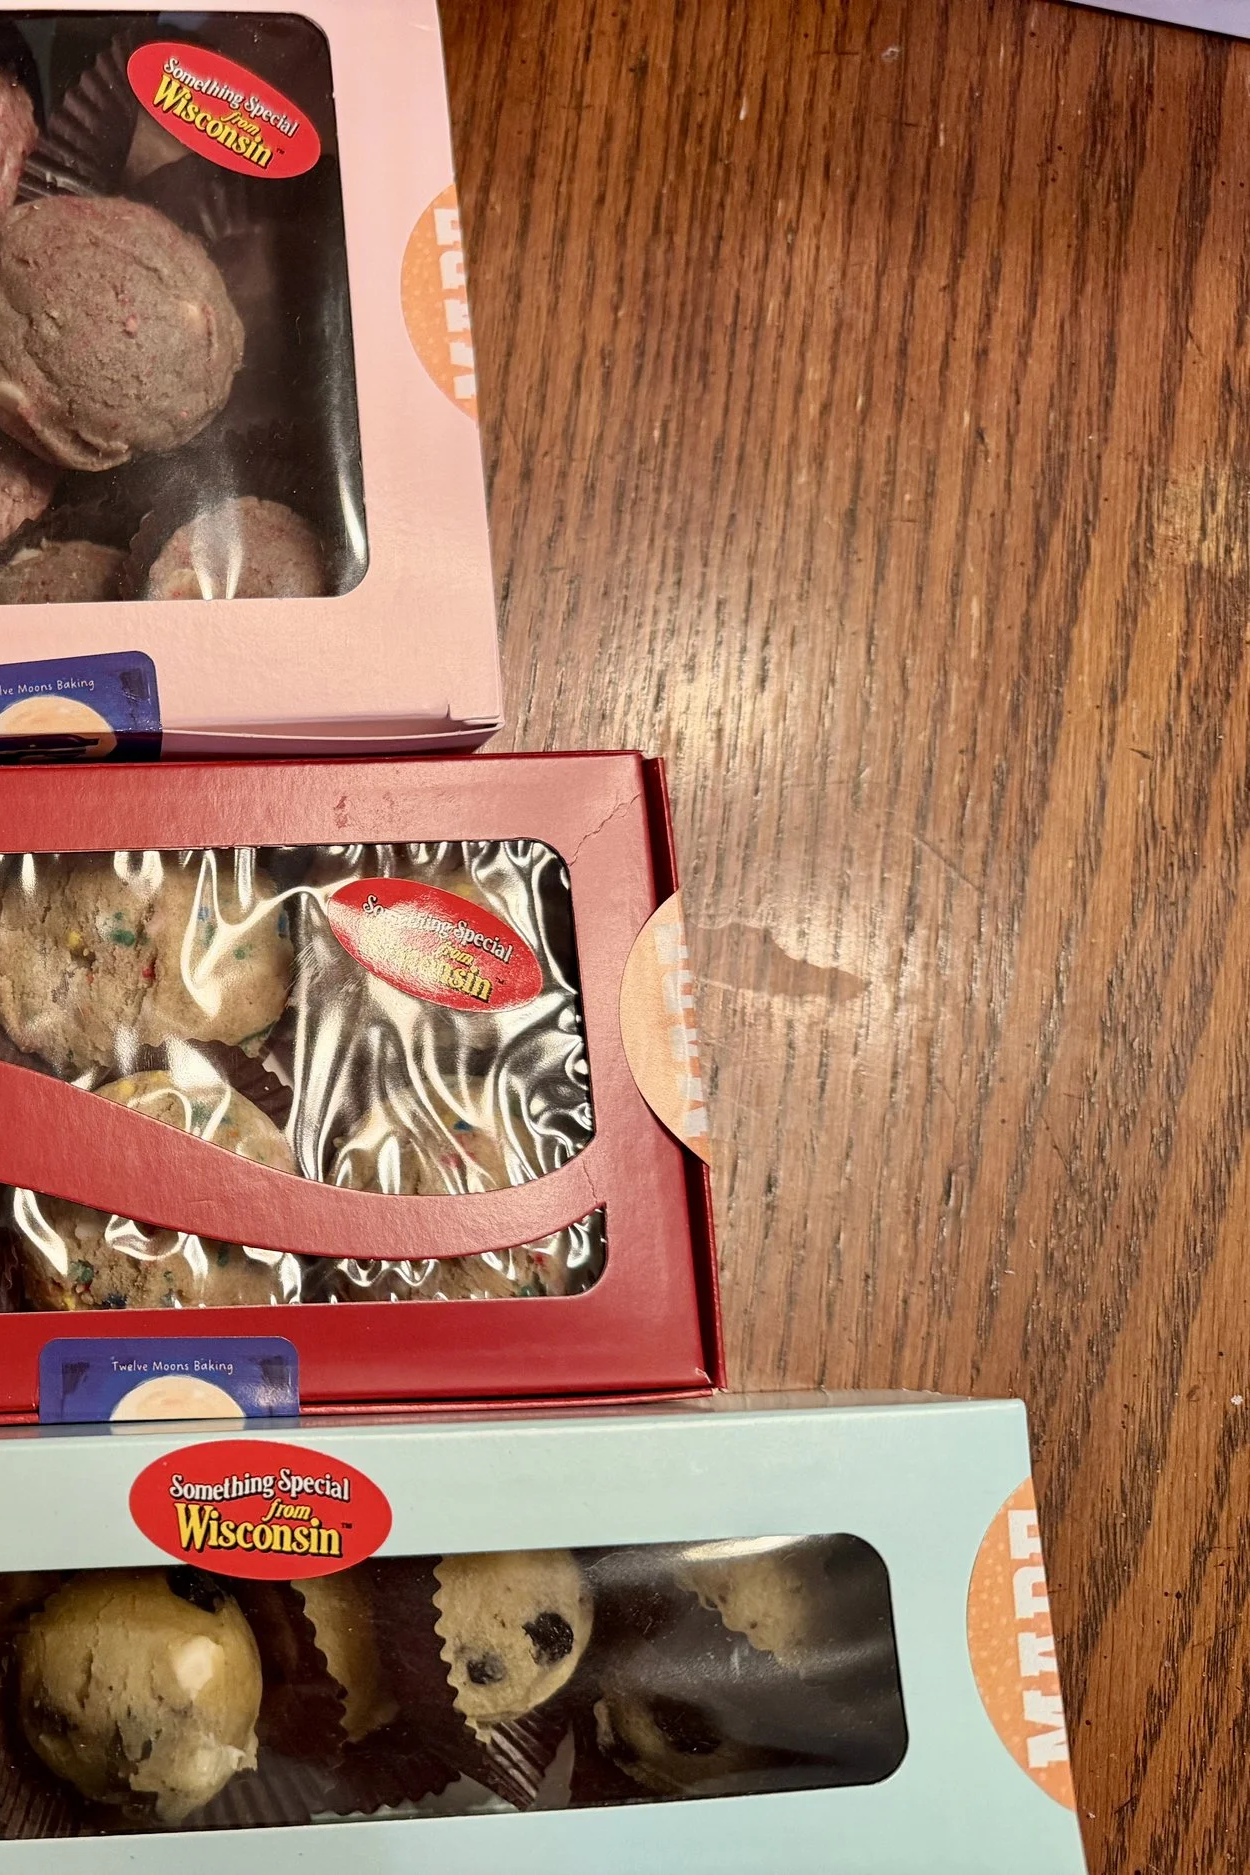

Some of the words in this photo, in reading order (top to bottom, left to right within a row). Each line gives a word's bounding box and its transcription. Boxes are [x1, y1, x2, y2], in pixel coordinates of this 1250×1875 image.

[163, 57, 244, 110] Something
[243, 96, 299, 138] Special
[152, 73, 273, 169] Wisconsin
[220, 110, 261, 136] from
[17, 682, 53, 695] Moons
[57, 677, 95, 692] Baking
[453, 920, 514, 965] Special
[111, 1360, 148, 1373] Twelve
[152, 1360, 189, 1372] Moons
[194, 1359, 234, 1375] Baking
[169, 1472, 277, 1502] Something
[277, 1468, 351, 1502] Special
[261, 1498, 313, 1522] from
[173, 1502, 344, 1557] Wisconsin
